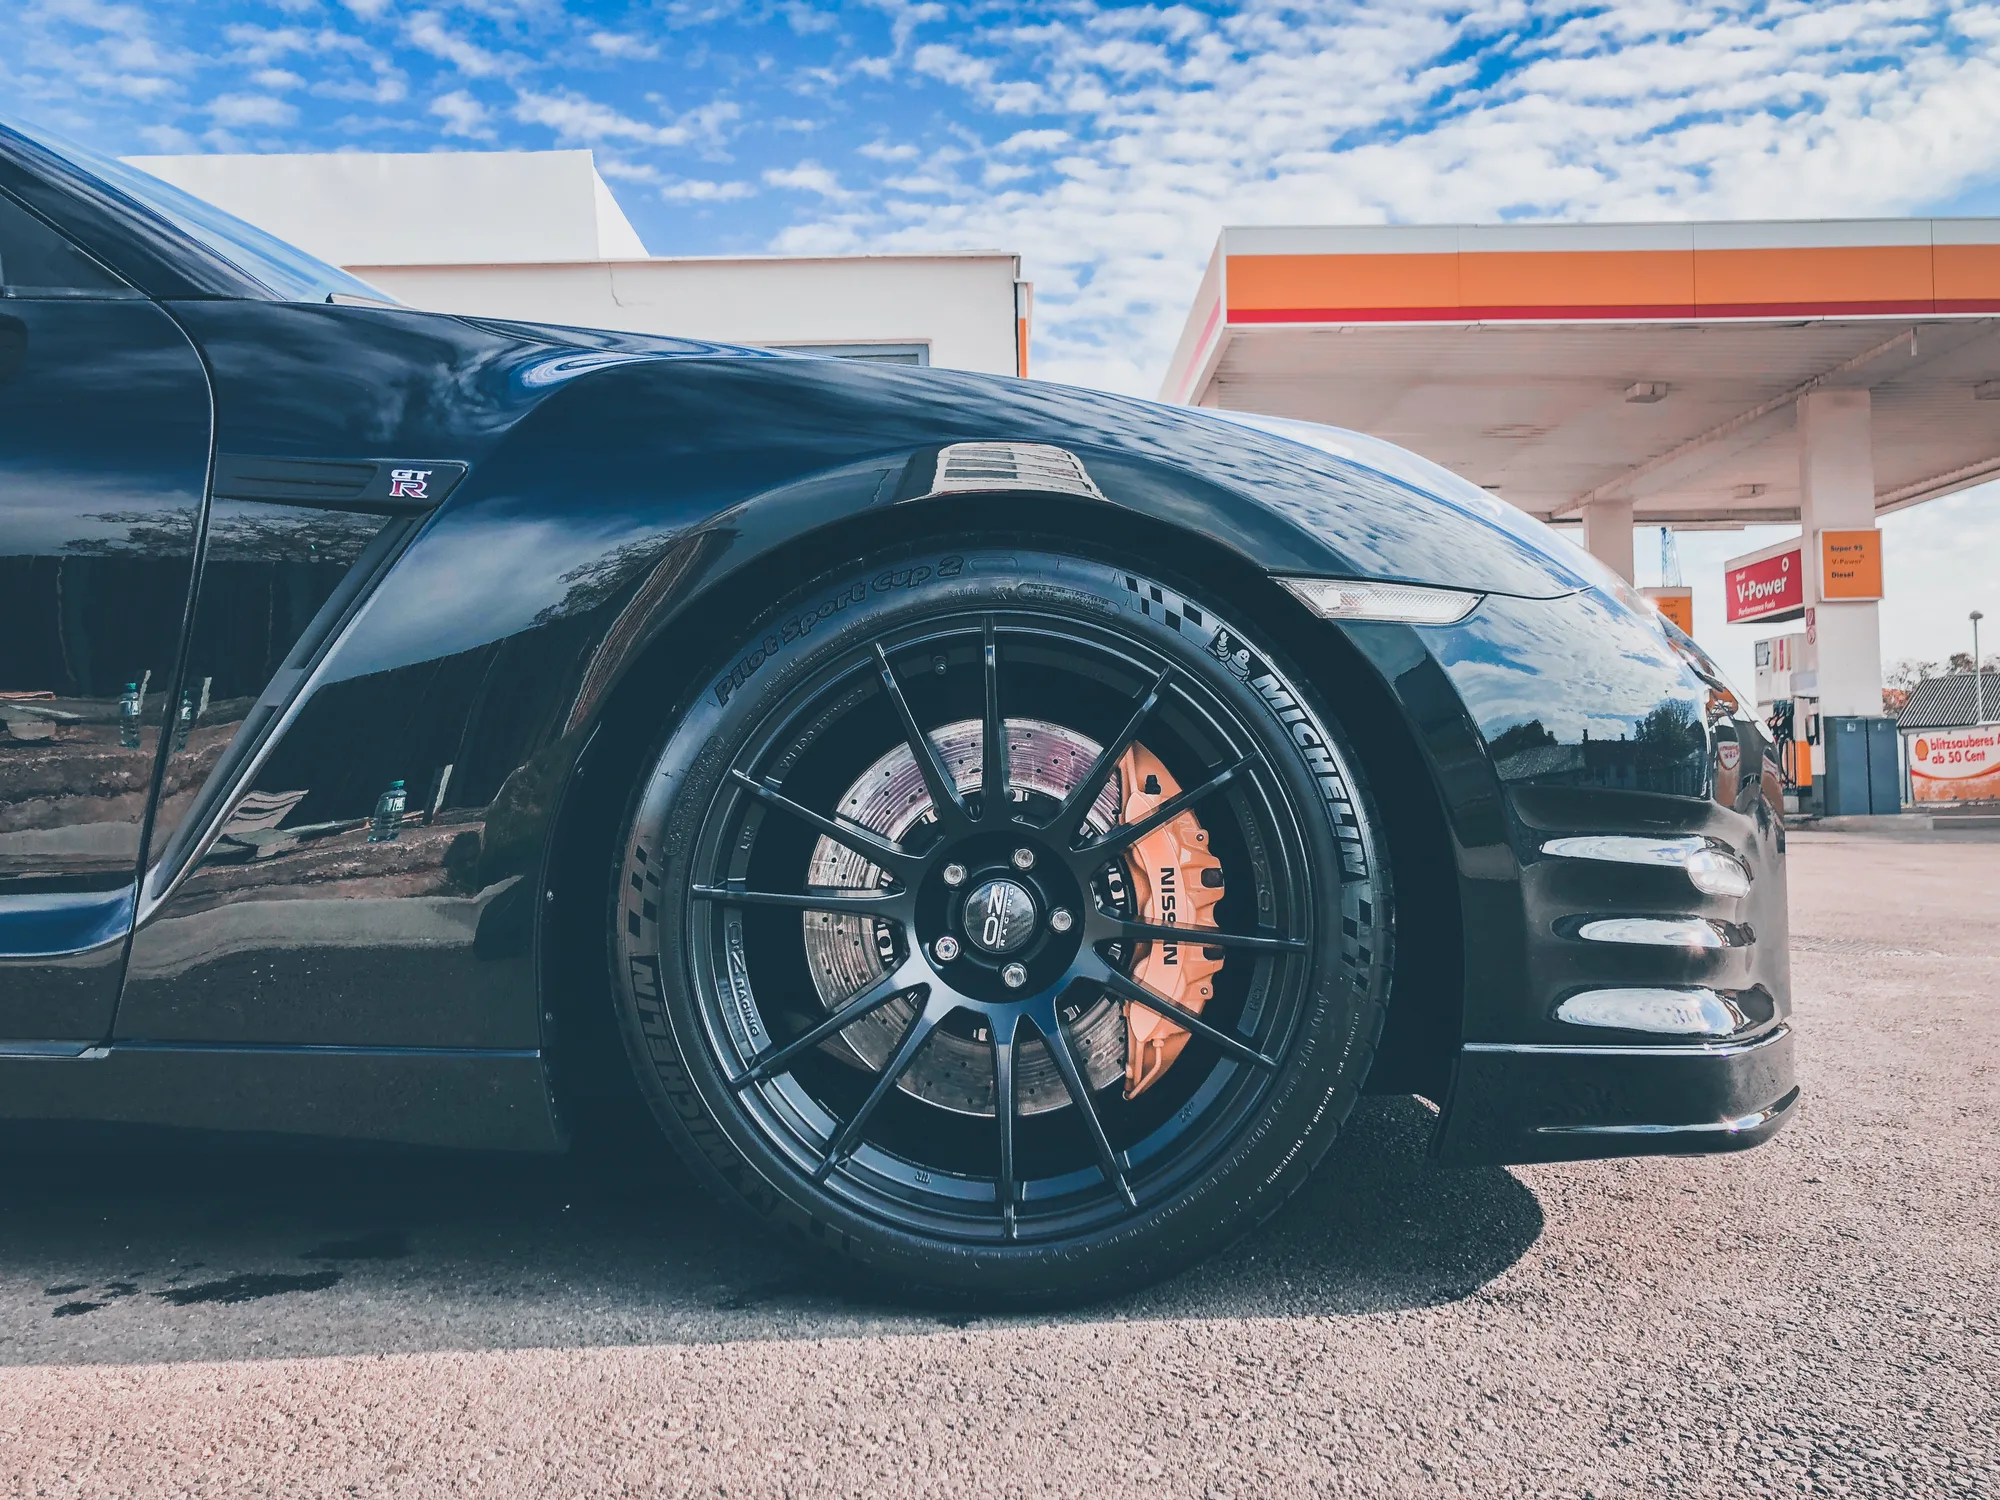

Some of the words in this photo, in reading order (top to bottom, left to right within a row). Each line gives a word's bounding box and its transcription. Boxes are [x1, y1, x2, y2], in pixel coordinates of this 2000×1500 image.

[389, 479, 428, 498] R
[391, 469, 432, 480] GT
[1736, 576, 1787, 603] V-Power
[714, 635, 780, 708] Pilot
[781, 582, 866, 646] Sport
[871, 565, 932, 593] Cup
[937, 555, 964, 577] 2
[1930, 734, 1994, 751] blitzsauberes
[1931, 752, 1945, 764] ab
[1948, 751, 1962, 763] 50
[1964, 750, 1986, 763] Cent
[1252, 673, 1367, 876] MICHELIN
[1000, 888, 1015, 947] RACING
[1160, 867, 1178, 965] NISSN
[735, 977, 761, 1038] RACING
[631, 960, 738, 1168] MICHELIN
